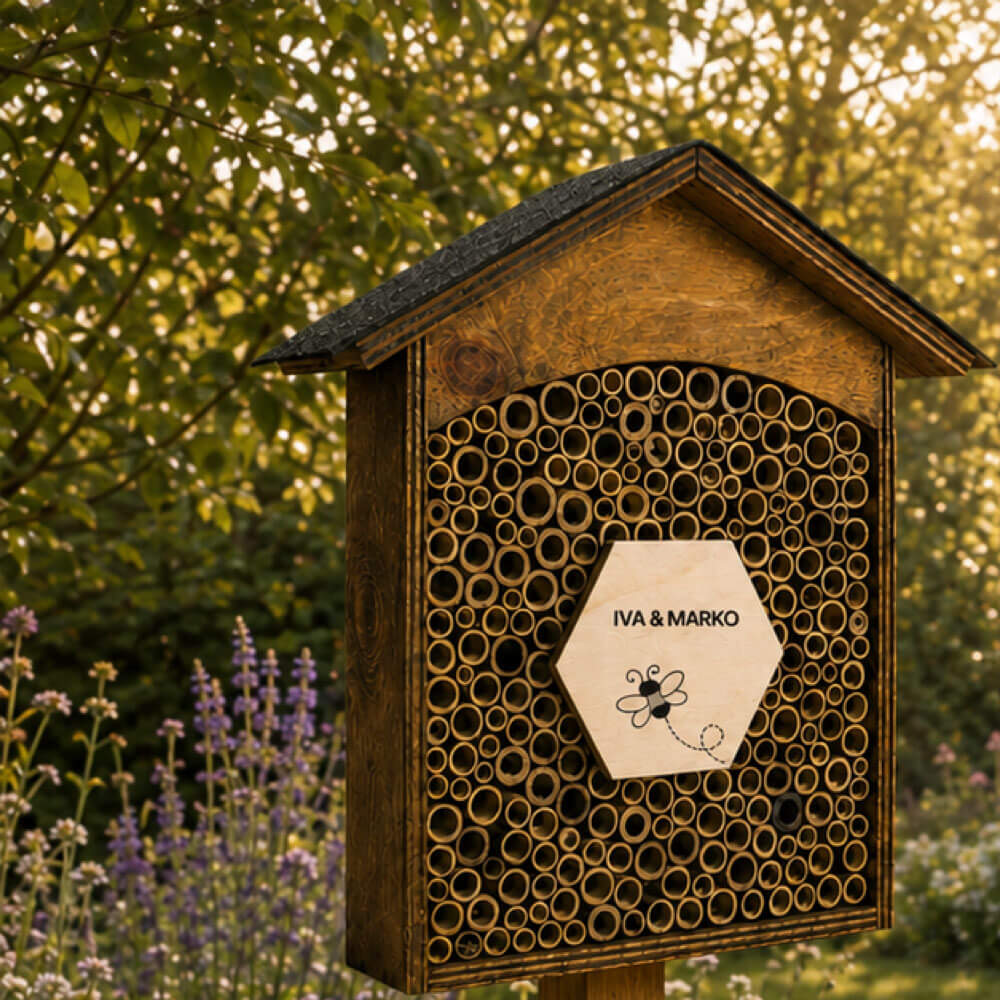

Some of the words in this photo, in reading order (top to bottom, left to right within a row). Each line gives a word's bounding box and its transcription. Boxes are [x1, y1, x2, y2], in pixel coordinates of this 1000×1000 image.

[613, 610, 646, 627] IVA
[650, 610, 664, 627] &
[668, 610, 740, 627] MARKO
